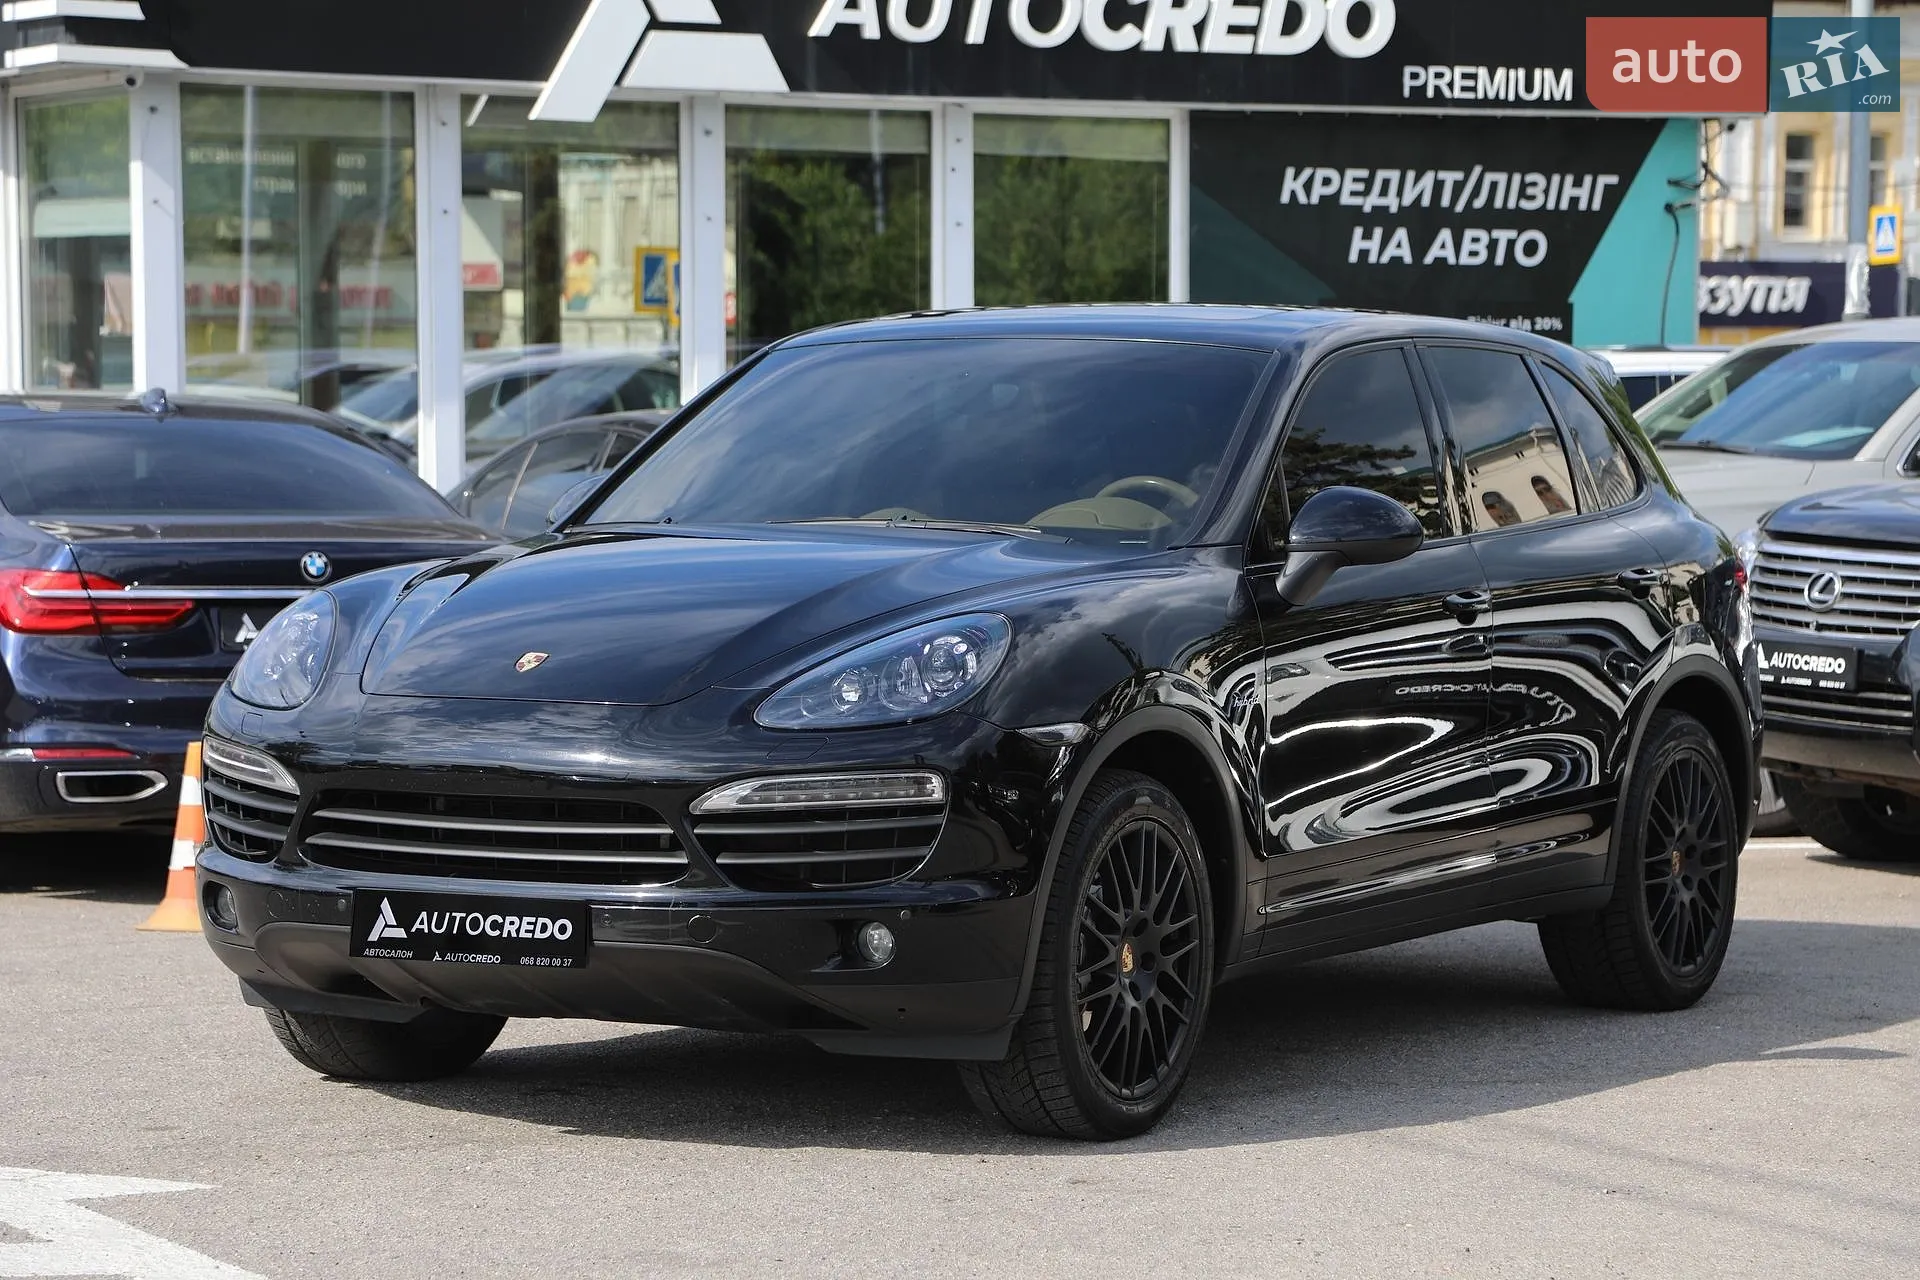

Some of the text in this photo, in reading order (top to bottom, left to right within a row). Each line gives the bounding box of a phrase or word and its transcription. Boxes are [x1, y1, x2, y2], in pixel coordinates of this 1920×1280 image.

[1402, 65, 1574, 103] PREMIUM
[1280, 165, 1620, 214] КРЕДИТ/ЛІЗІНГ
[1348, 226, 1549, 268] НА АВТО
[1769, 651, 1846, 674] AUTOCREDO
[411, 911, 573, 940] AUTOCREDO
[363, 948, 413, 959] АВТОСАЛОН
[444, 952, 501, 964] AUTOCREDO
[520, 956, 573, 967] 068 820 00 37
